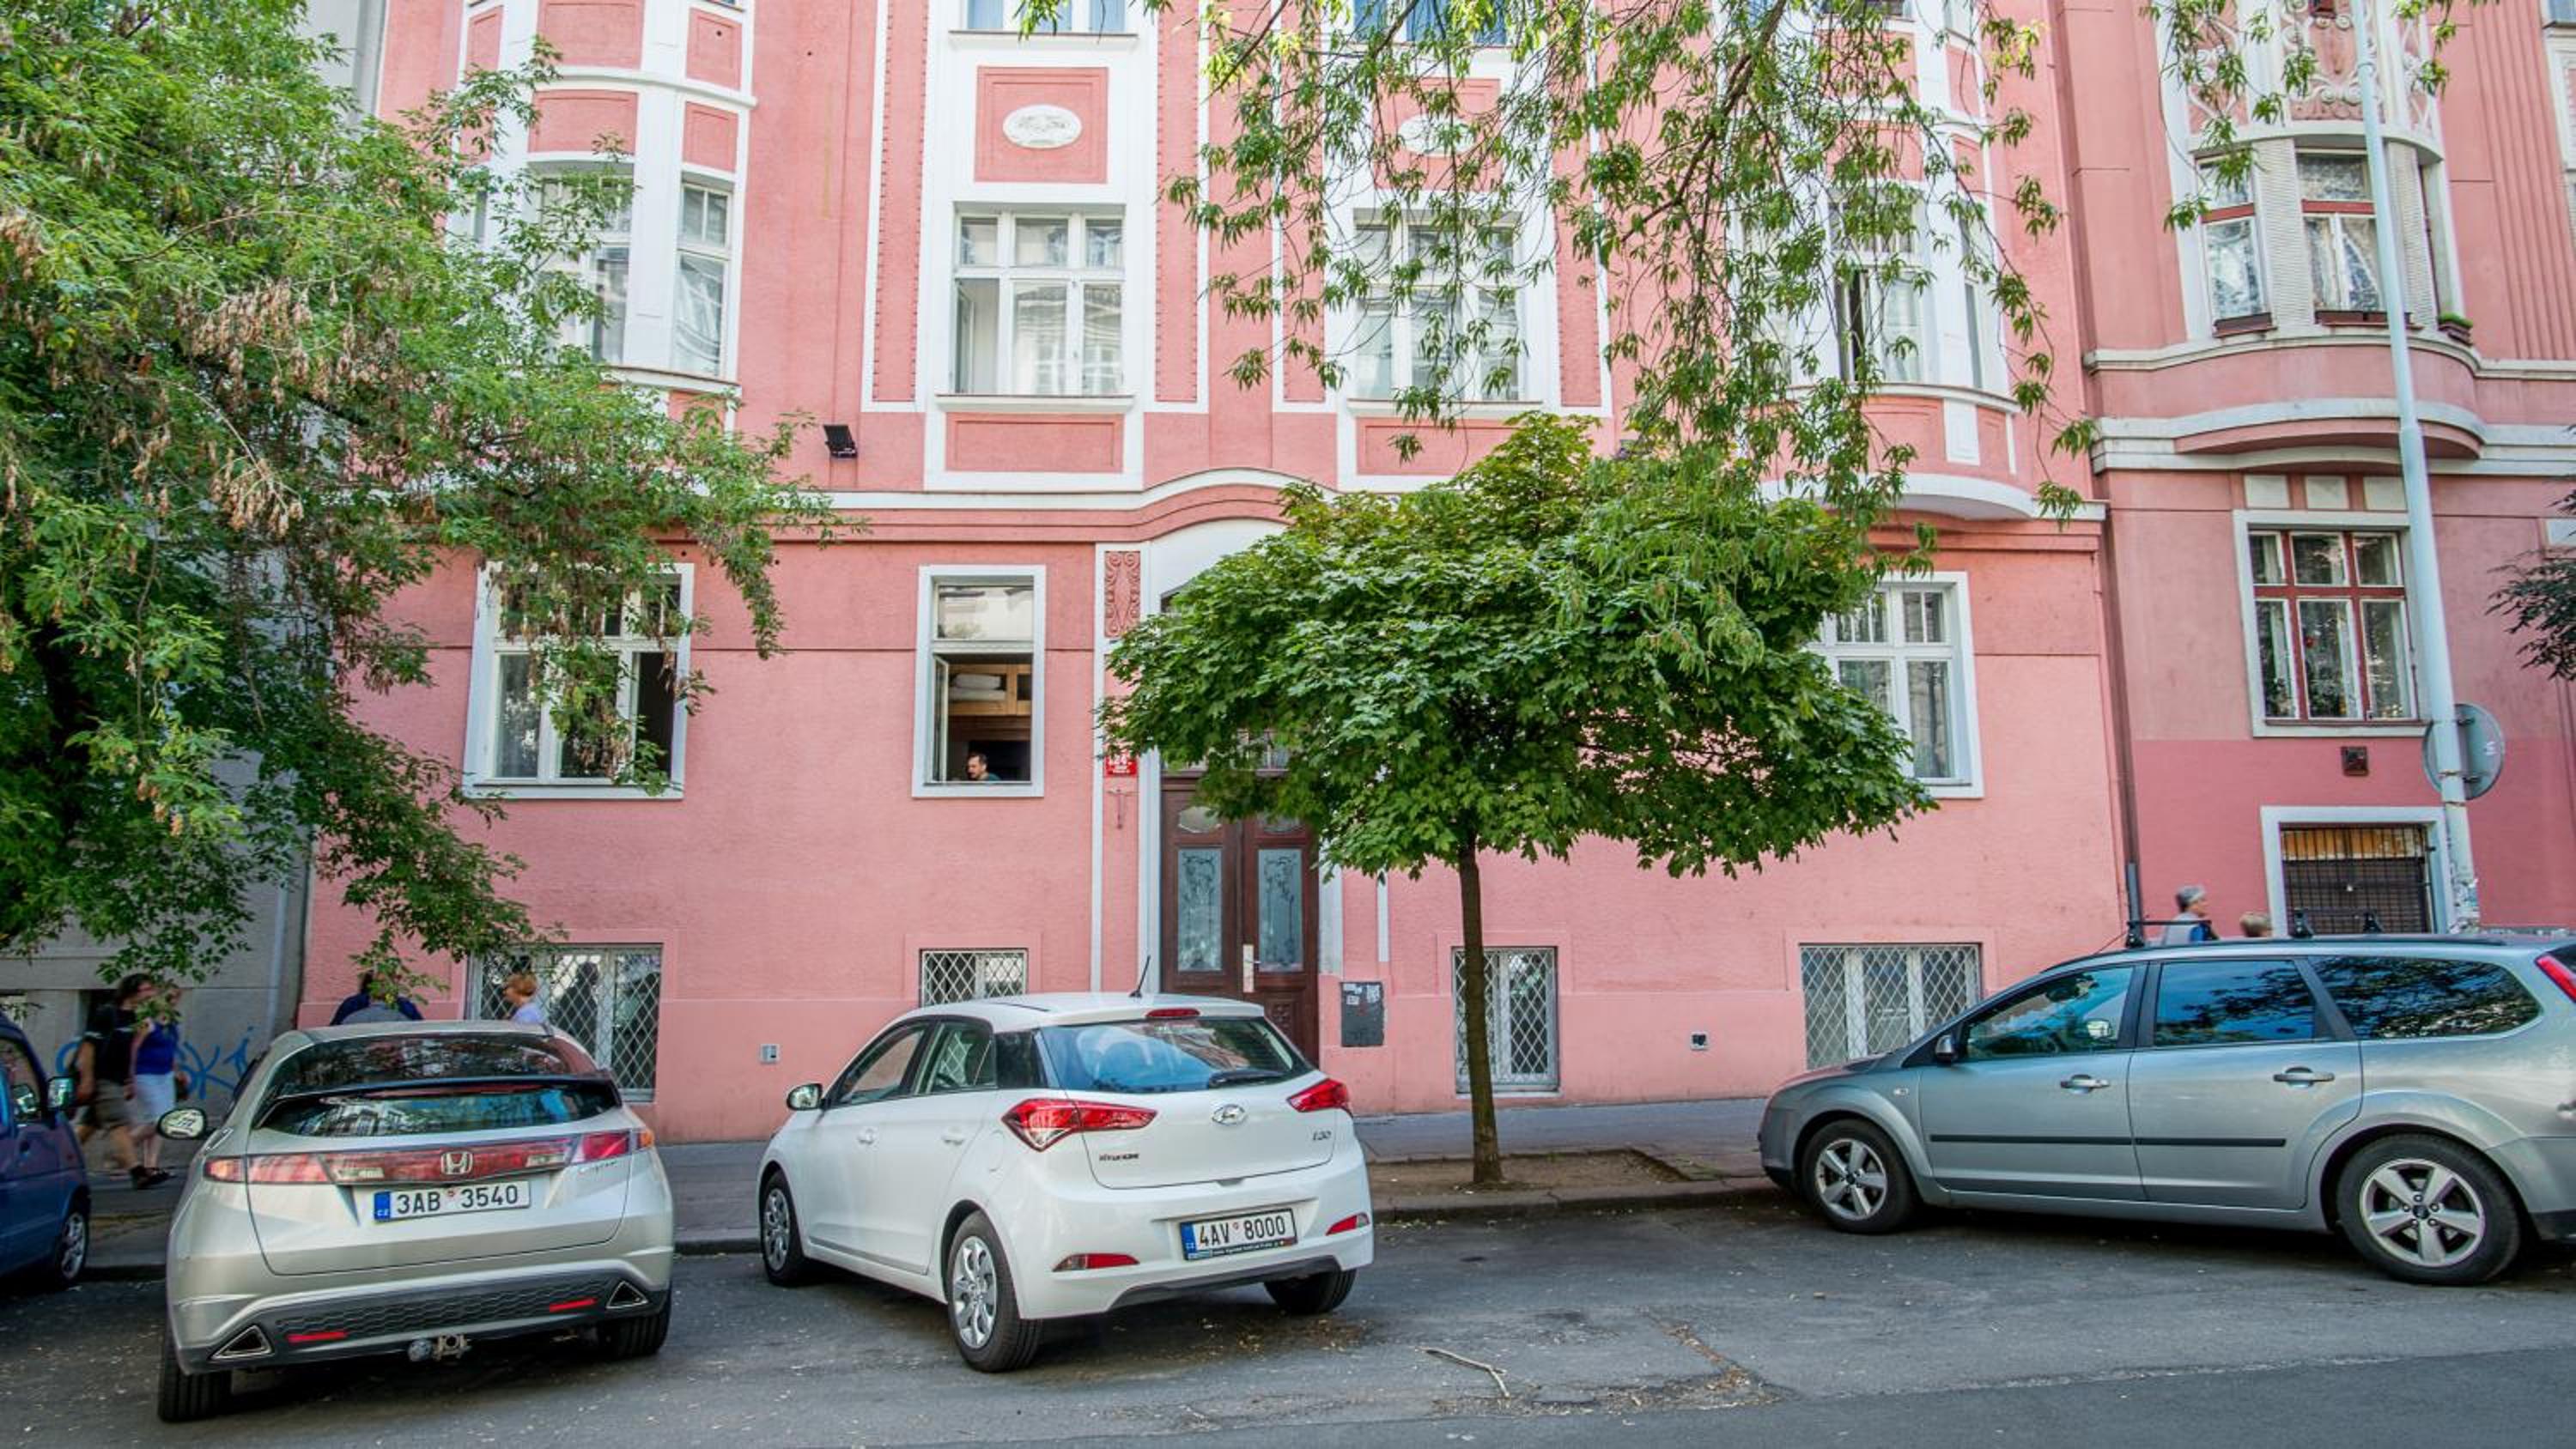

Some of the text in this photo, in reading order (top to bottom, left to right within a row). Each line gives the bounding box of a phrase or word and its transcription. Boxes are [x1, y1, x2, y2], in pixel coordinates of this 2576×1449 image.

[397, 1185, 518, 1214] 3AB 3540
[1200, 1216, 1286, 1246] 4AV 8000
